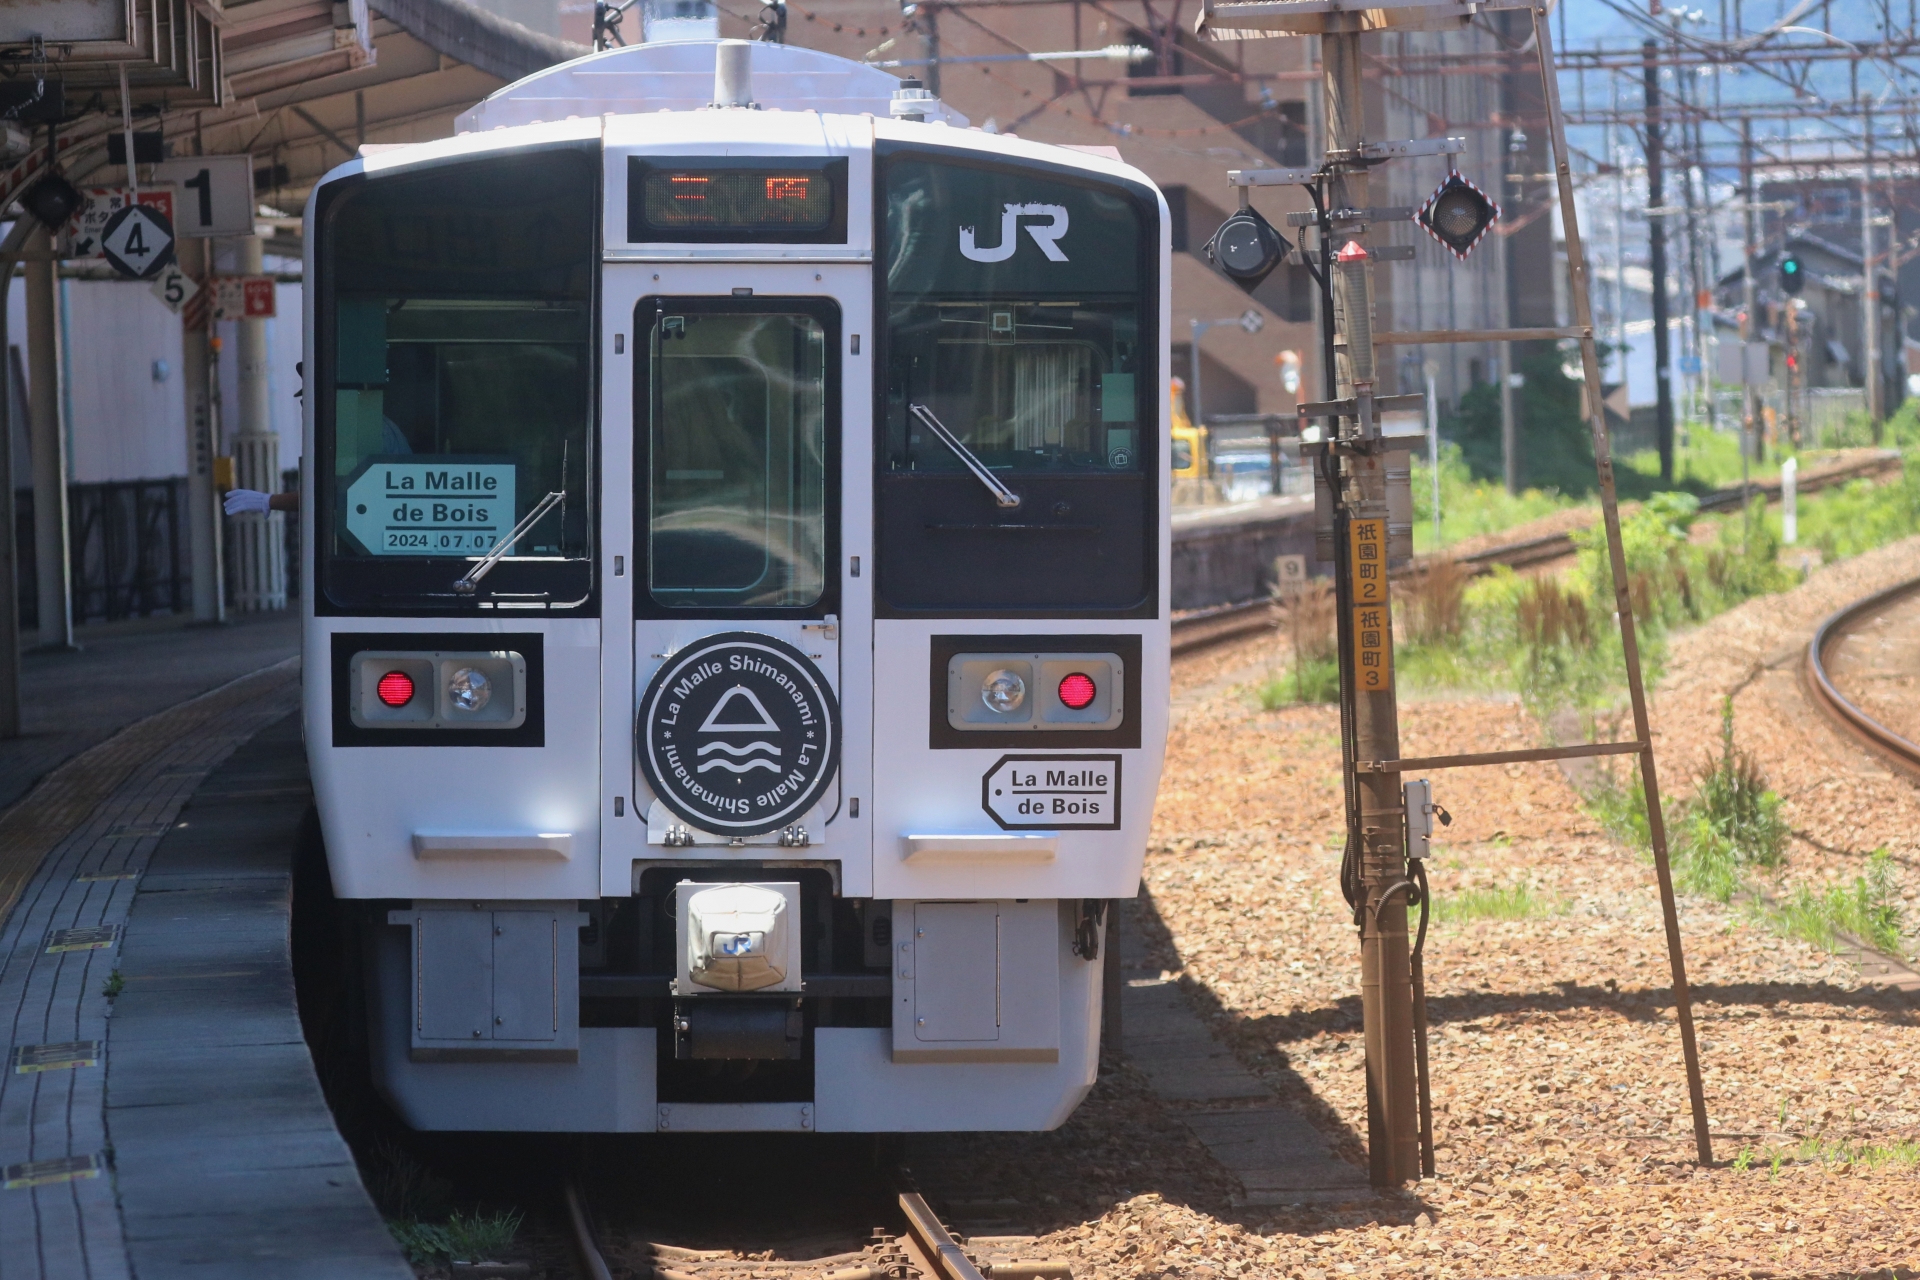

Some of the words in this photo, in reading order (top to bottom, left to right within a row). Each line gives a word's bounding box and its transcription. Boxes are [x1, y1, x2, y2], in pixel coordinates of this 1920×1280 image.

[184, 168, 213, 227] 1
[124, 222, 151, 257] 4
[959, 201, 1070, 263] JR
[164, 274, 185, 303] 5
[385, 471, 414, 490] La
[425, 471, 497, 491] Malle
[393, 503, 424, 522] de
[432, 503, 489, 522] Bois
[661, 702, 681, 725] La
[673, 662, 723, 700] Malle
[729, 655, 818, 726] Shimanami
[798, 743, 818, 766] La
[661, 744, 750, 814] Shimanami
[757, 769, 806, 807] Malle
[1012, 770, 1037, 787] La
[1046, 770, 1108, 787] Malle
[1018, 798, 1045, 815] de
[1052, 798, 1100, 815] Bois
[723, 936, 752, 955] JR
